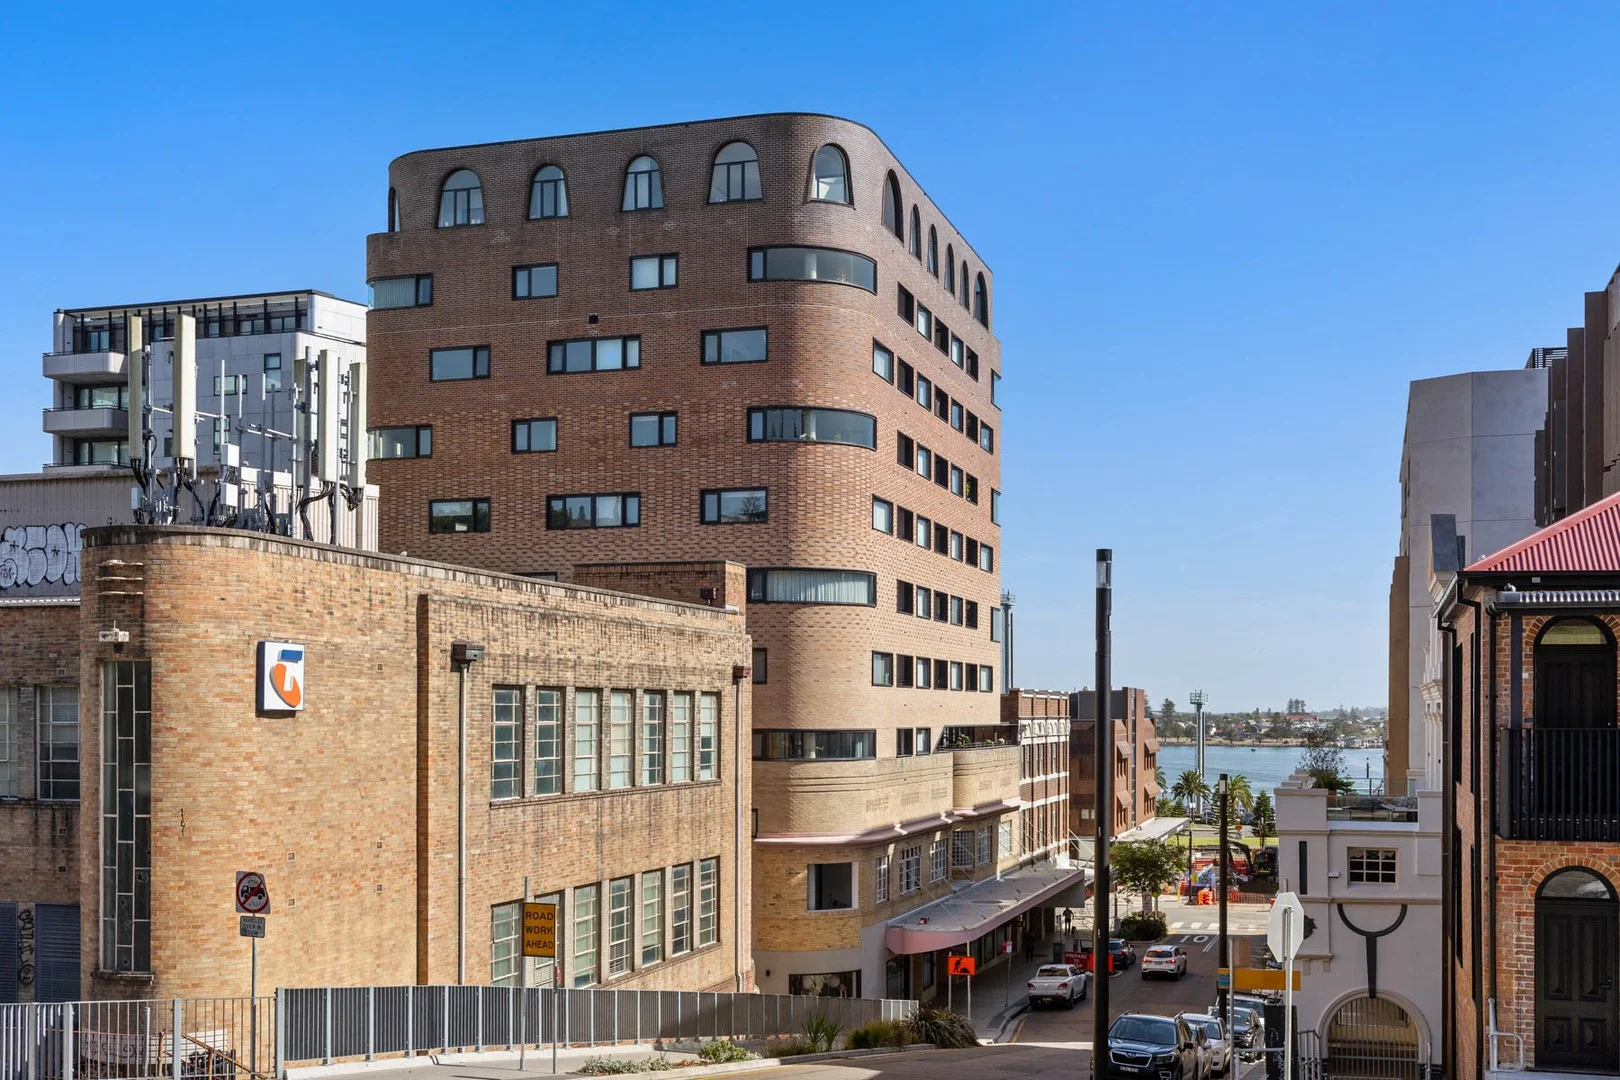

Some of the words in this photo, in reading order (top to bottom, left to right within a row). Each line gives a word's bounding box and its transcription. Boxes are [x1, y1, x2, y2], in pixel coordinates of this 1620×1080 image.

[525, 911, 554, 921] ROAD
[525, 926, 553, 935] WORK
[525, 940, 554, 949] AHEAD
